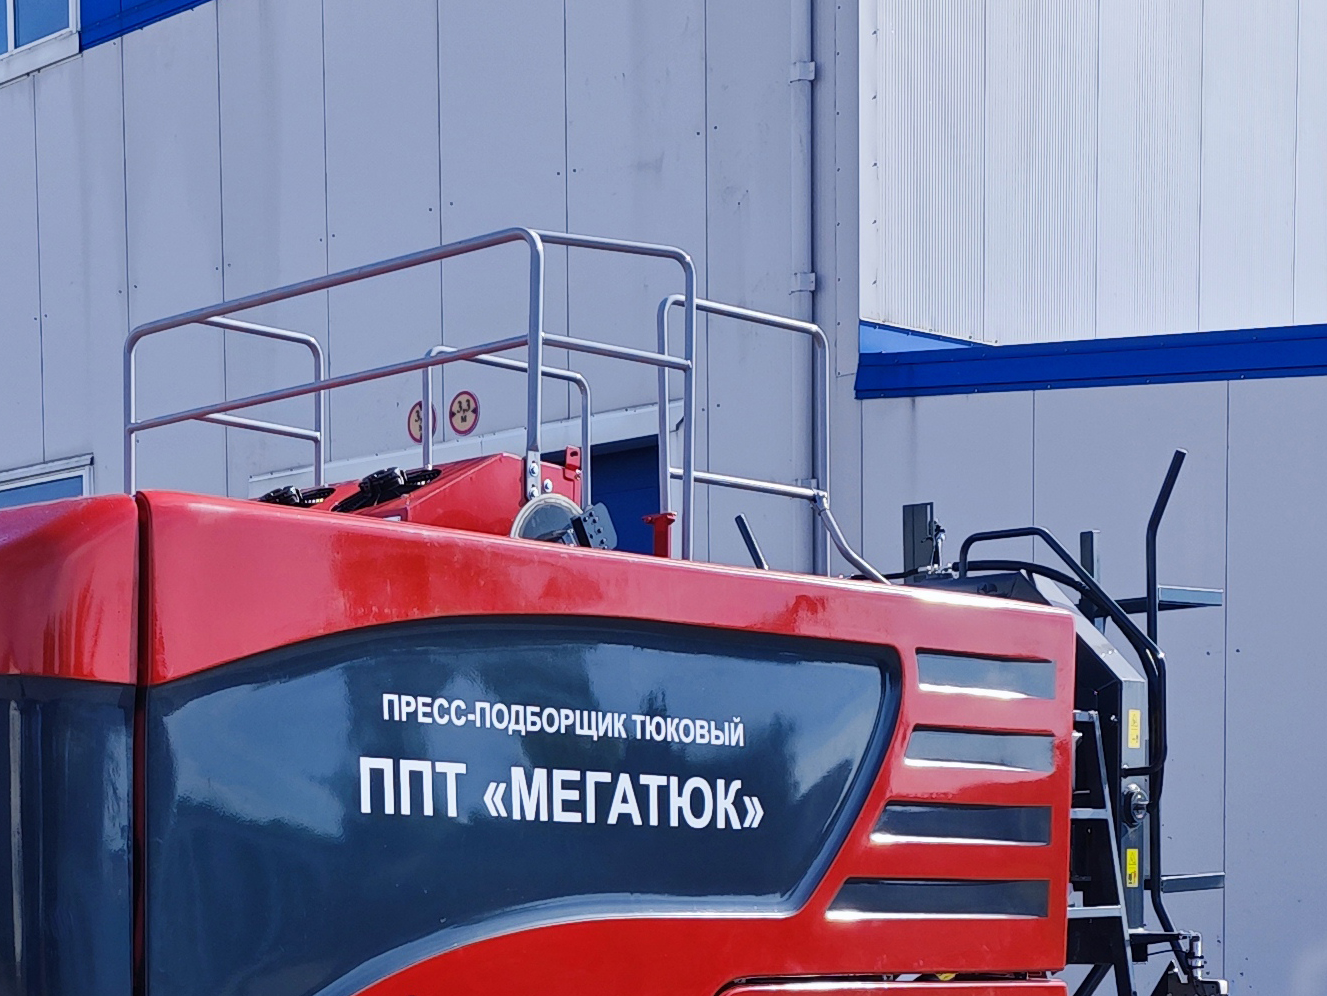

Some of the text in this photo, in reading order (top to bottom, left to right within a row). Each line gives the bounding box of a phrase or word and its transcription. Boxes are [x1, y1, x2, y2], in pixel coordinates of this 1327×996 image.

[457, 399, 471, 414] 3,3
[382, 693, 745, 747] ПРЕСС-ПОДБОРЩИК ТЮКОВЫЙ
[359, 756, 765, 830] ППТ «МЕГАТЮК»
